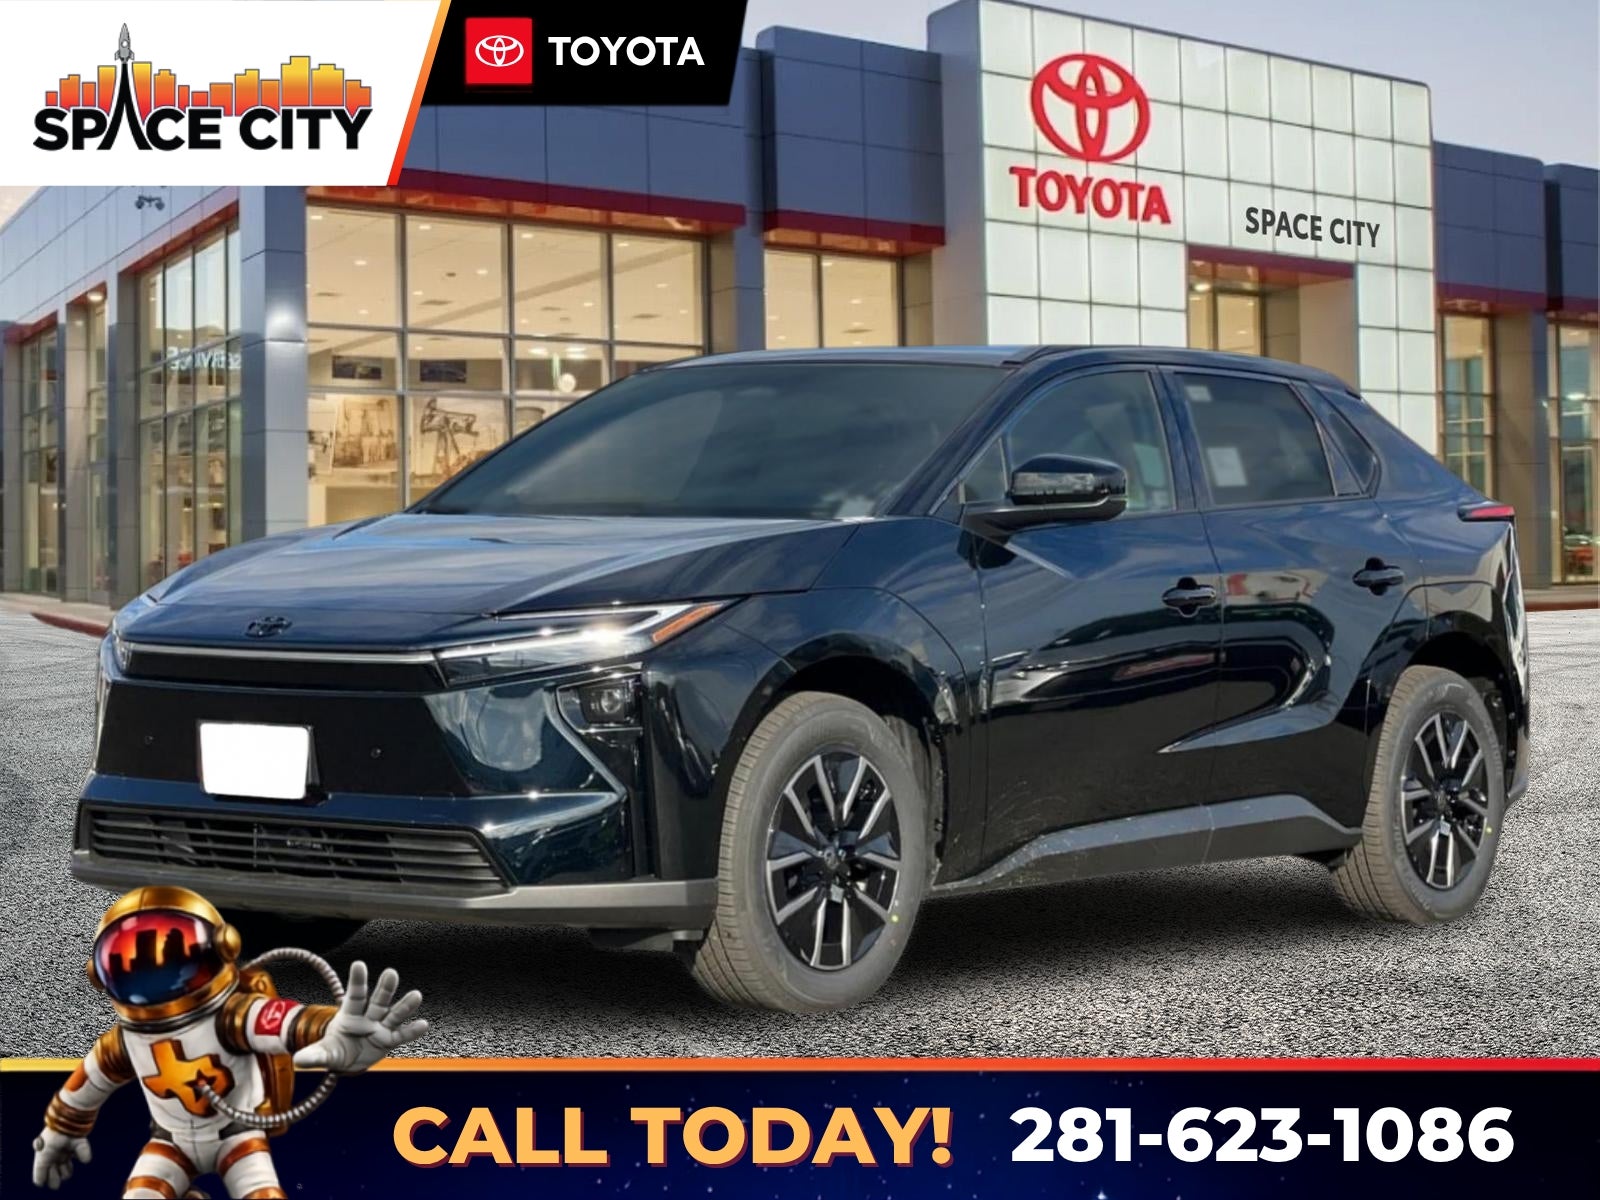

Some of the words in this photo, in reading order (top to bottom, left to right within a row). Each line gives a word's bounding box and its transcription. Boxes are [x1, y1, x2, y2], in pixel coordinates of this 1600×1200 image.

[1009, 166, 1172, 225] TOYOTA
[1245, 206, 1323, 242] SPACE
[1330, 217, 1381, 249] CITY
